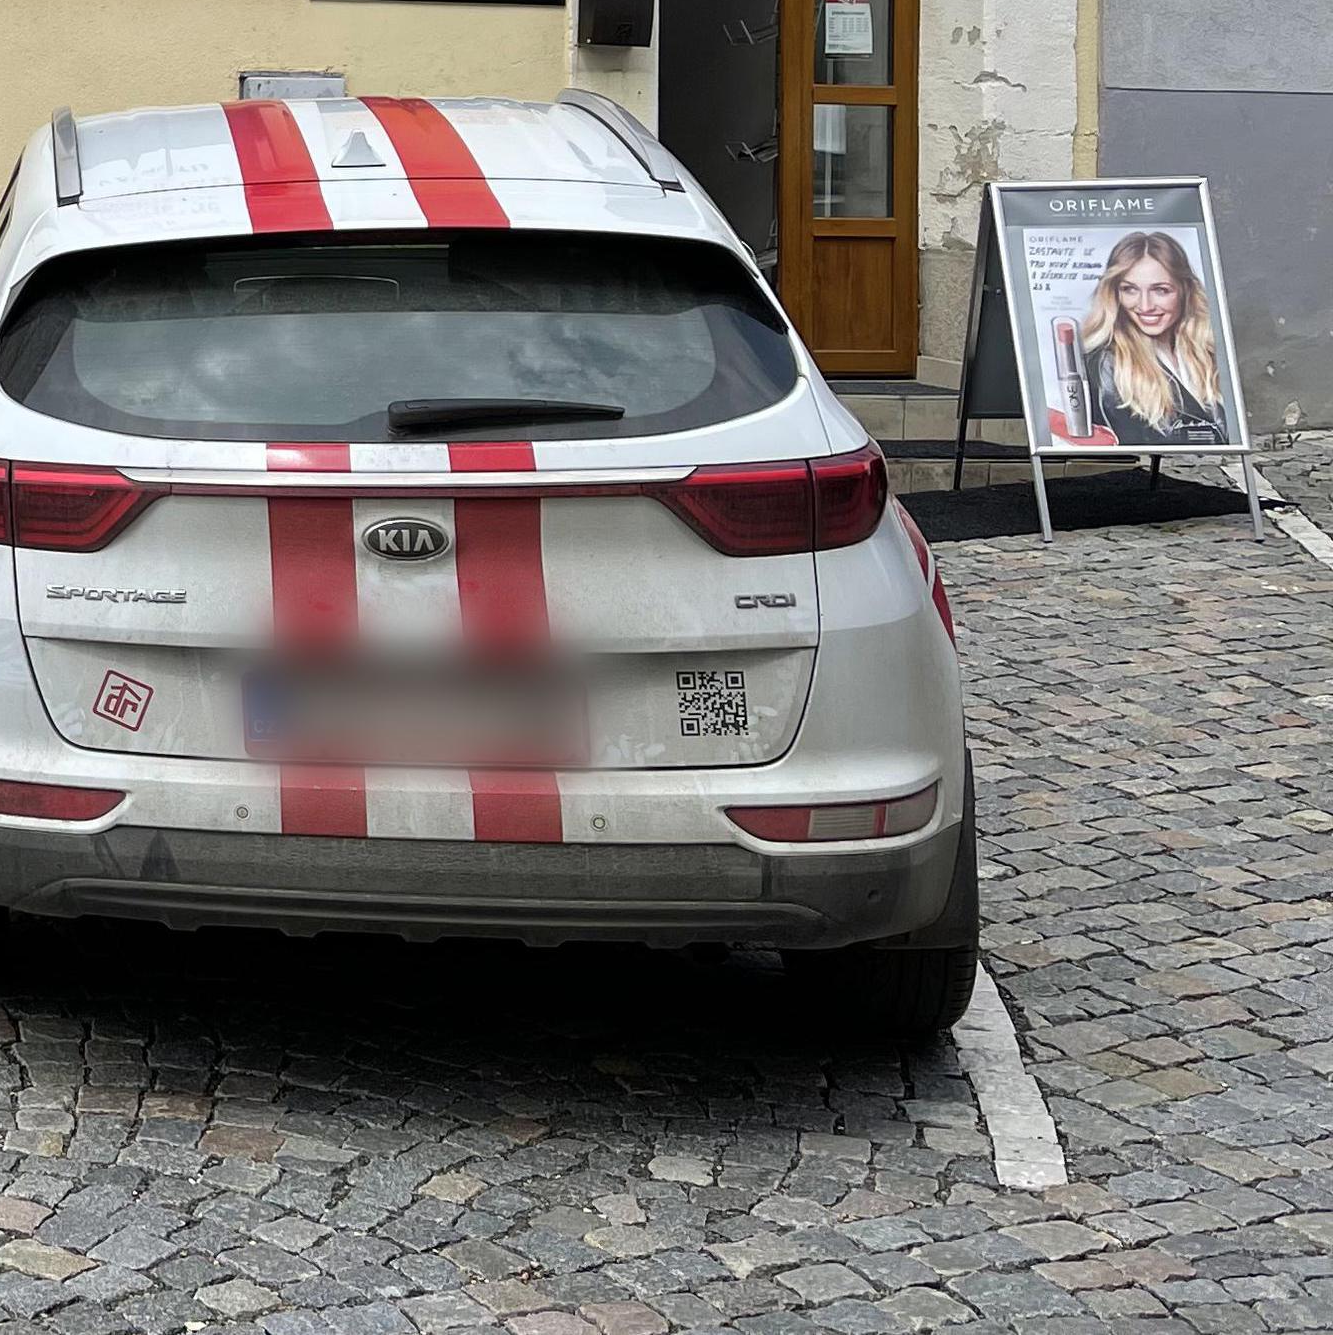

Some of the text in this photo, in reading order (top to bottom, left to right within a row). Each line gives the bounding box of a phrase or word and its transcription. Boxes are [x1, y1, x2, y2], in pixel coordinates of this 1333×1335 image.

[1049, 198, 1155, 212] ORIFLAME
[378, 528, 436, 554] KIA
[46, 584, 187, 604] SPORTAGE
